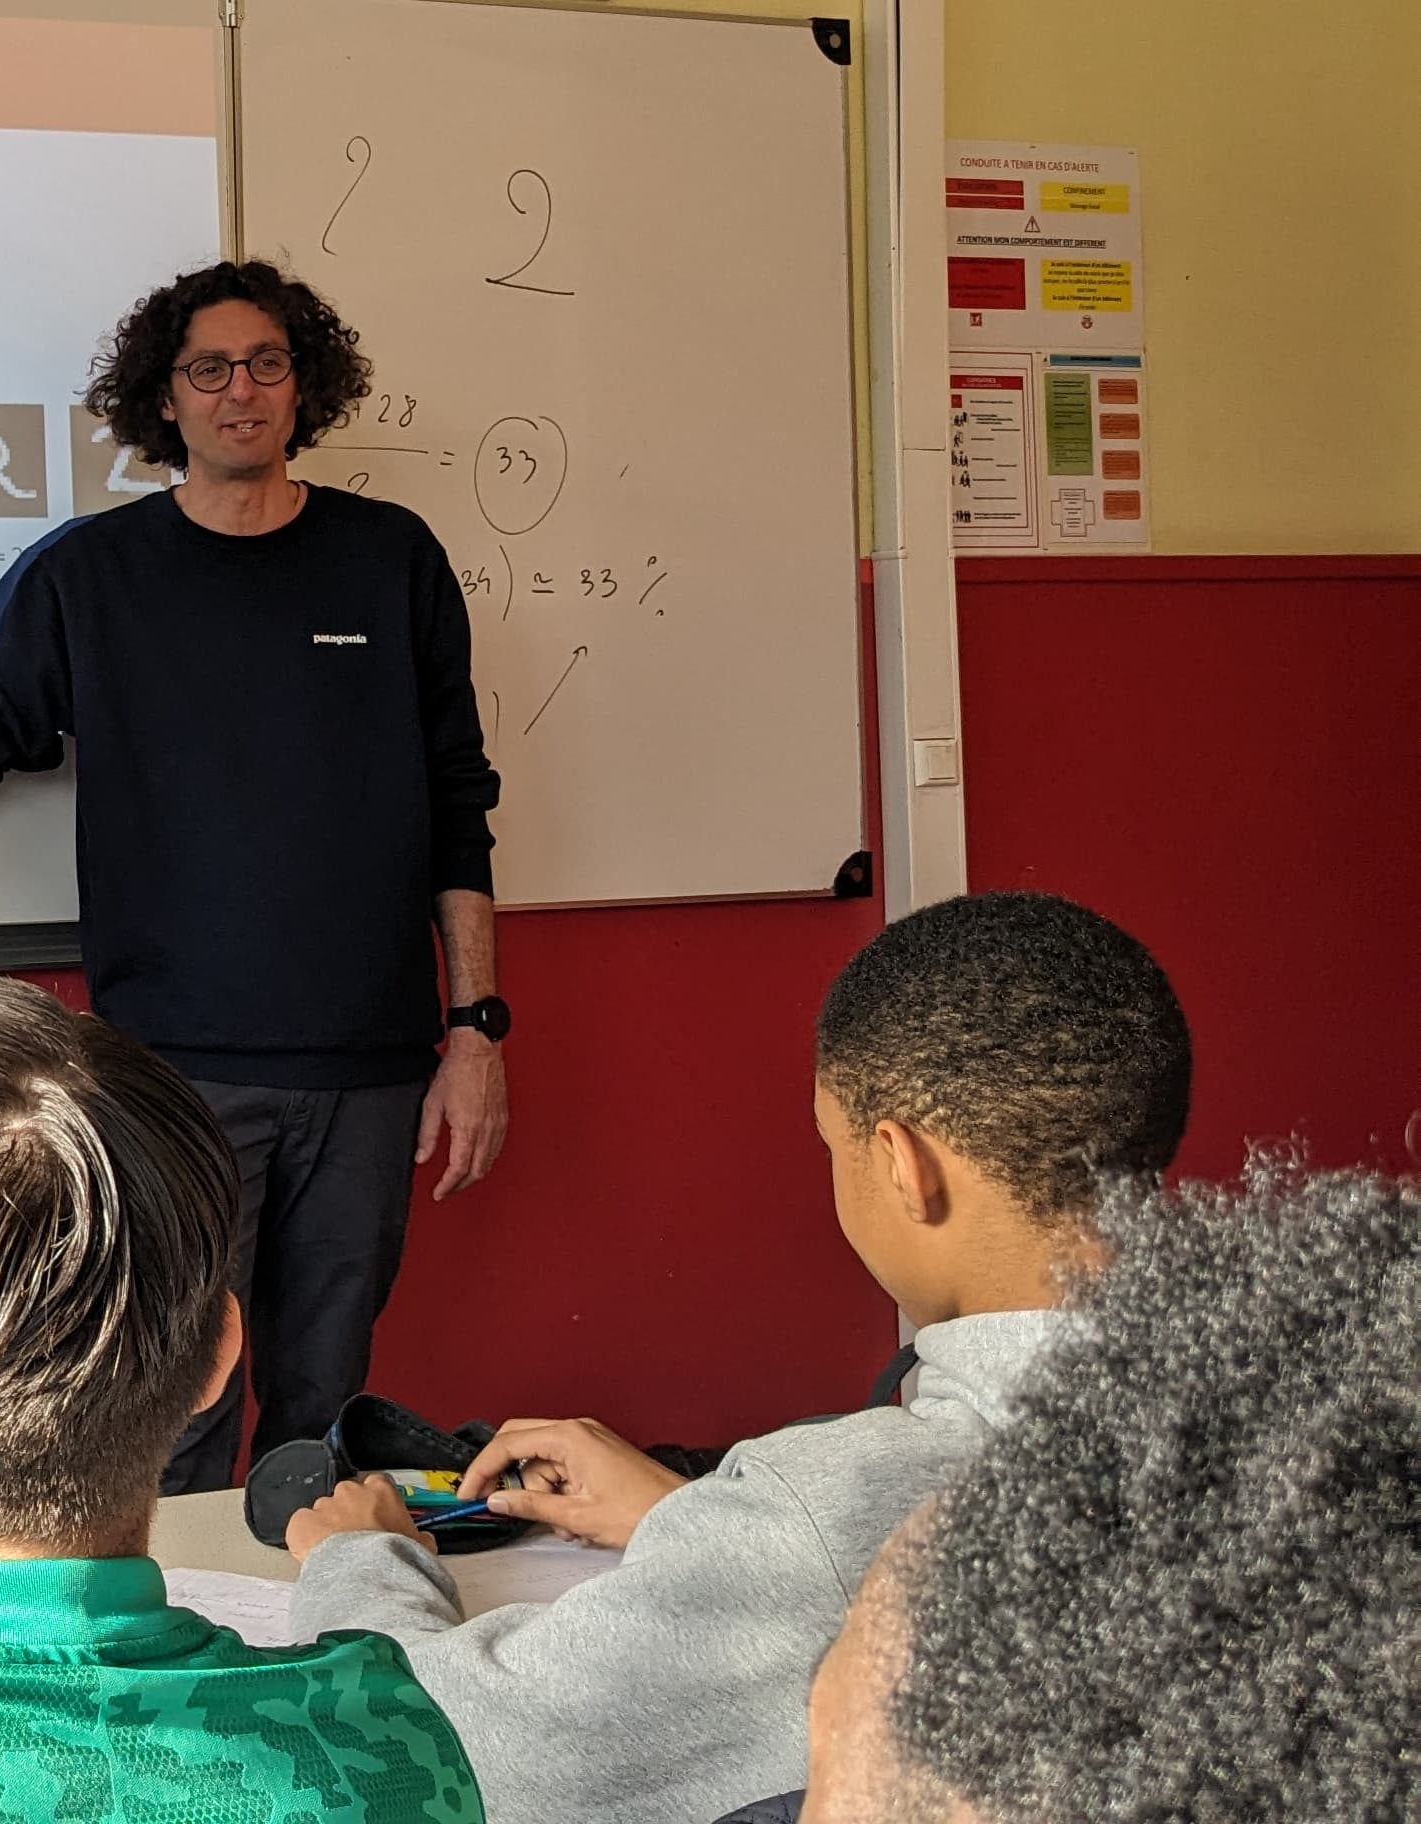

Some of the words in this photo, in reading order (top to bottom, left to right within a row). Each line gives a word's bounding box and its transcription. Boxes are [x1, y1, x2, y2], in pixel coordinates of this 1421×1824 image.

[960, 157, 1002, 169] CONDUITE
[1011, 159, 1034, 171] TENIR
[1036, 161, 1046, 171] EN
[1047, 161, 1063, 172] CAS
[1064, 161, 1099, 173] D'ALERTE
[485, 169, 575, 296] 2
[956, 235, 993, 245] ATTENTION
[378, 394, 417, 428] 28
[496, 446, 538, 484] 33
[580, 568, 618, 598] 33
[313, 633, 367, 646] patagonia
